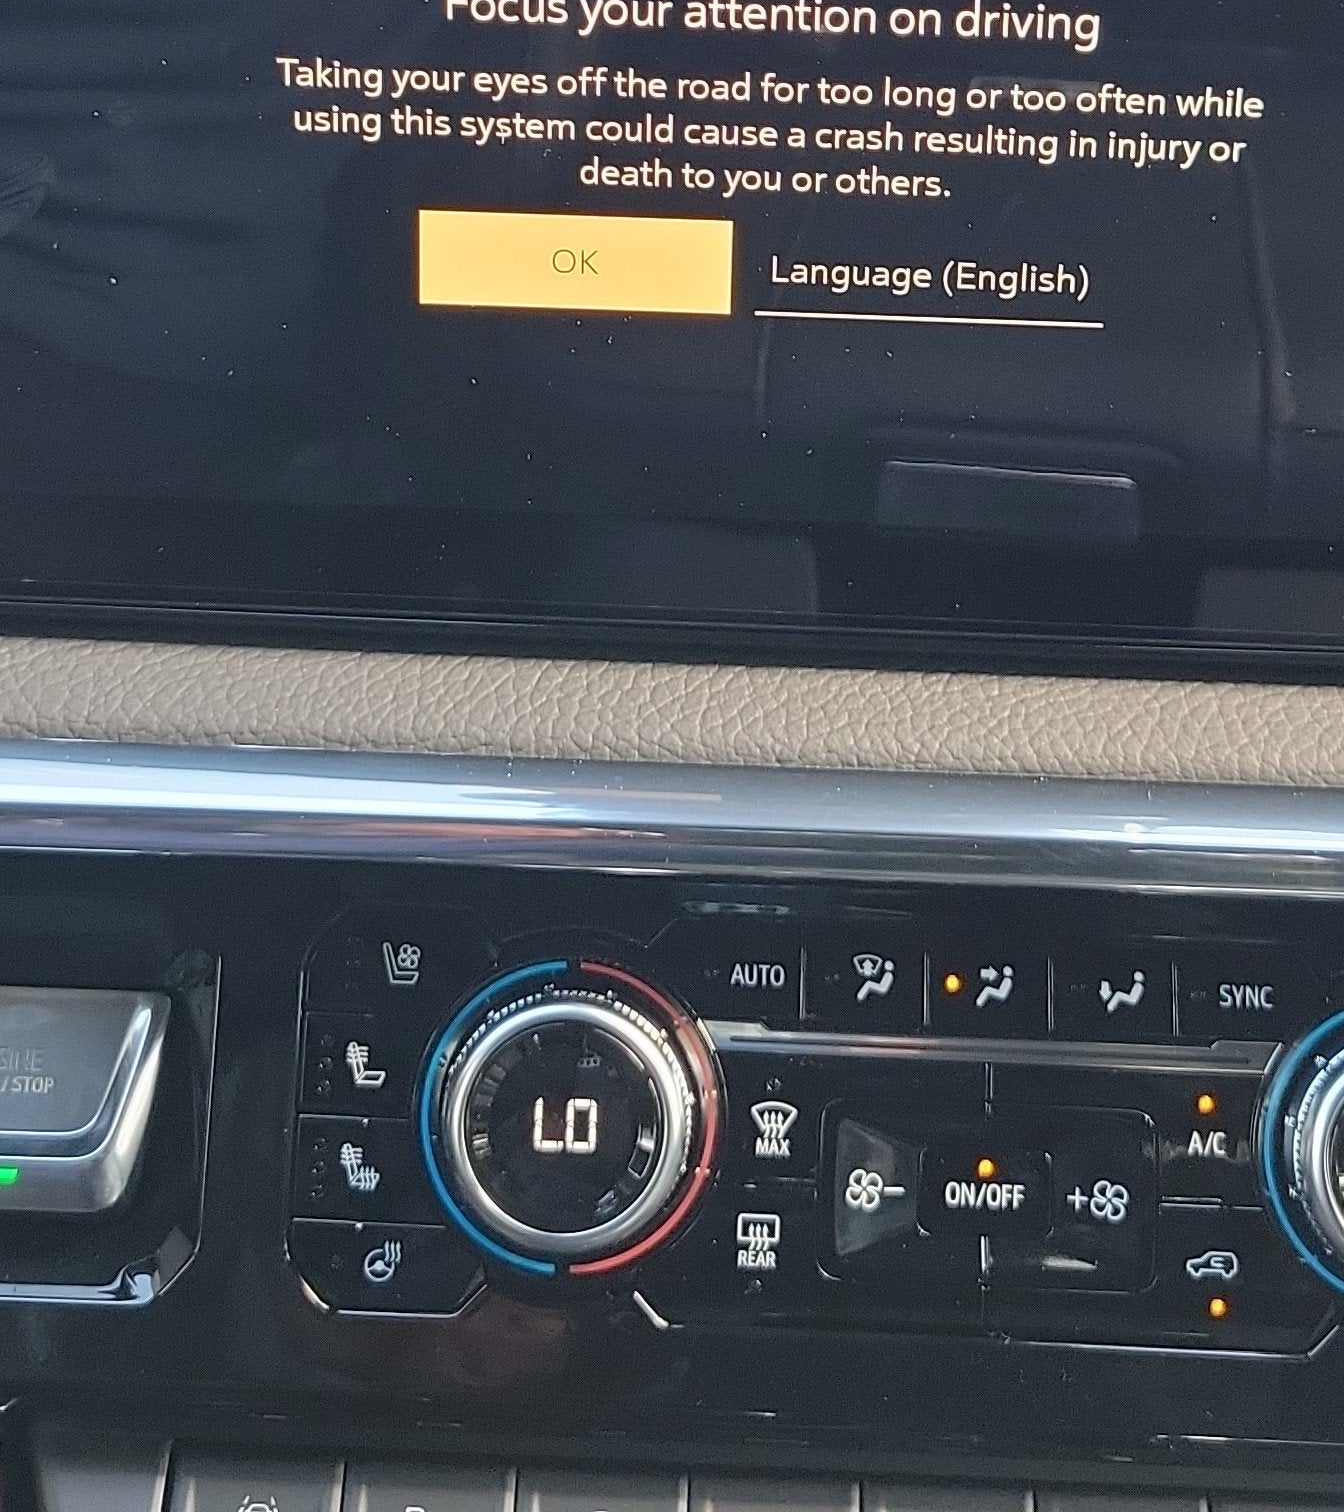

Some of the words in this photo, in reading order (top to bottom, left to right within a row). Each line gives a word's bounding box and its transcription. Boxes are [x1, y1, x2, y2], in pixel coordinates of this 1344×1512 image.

[888, 5, 942, 36] on
[276, 57, 384, 96] Taking
[390, 67, 466, 99] your
[473, 71, 549, 101] eyes
[557, 65, 610, 97] off
[613, 67, 668, 99] the
[677, 72, 752, 102] road
[761, 72, 810, 104] for
[818, 77, 874, 106] too
[883, 76, 956, 116] long
[966, 84, 1003, 110] or
[1011, 83, 1067, 113] too
[1075, 83, 1165, 116] often
[1176, 87, 1265, 119] while
[293, 106, 382, 142] using
[390, 107, 453, 136] this
[459, 113, 576, 145] system
[584, 113, 675, 144] could
[682, 122, 779, 148] cause
[786, 128, 806, 150] a
[814, 121, 903, 153] crash
[913, 125, 1059, 165] resulting
[1068, 130, 1097, 158] in
[1108, 131, 1202, 170] injury
[1208, 141, 1248, 164] or
[579, 156, 674, 188] death
[681, 162, 716, 189] to
[721, 168, 783, 198] you
[791, 169, 828, 193] or
[835, 166, 952, 198] others.
[551, 248, 599, 277] OK
[771, 256, 933, 293] Language
[942, 260, 1091, 302] (English)
[730, 964, 786, 988] AUTO
[1218, 984, 1274, 1009] SYNC
[755, 1139, 790, 1157] MAX
[1187, 1131, 1227, 1157] A/C
[944, 1181, 1025, 1210] ON/OFF
[737, 1250, 776, 1268] REAR
